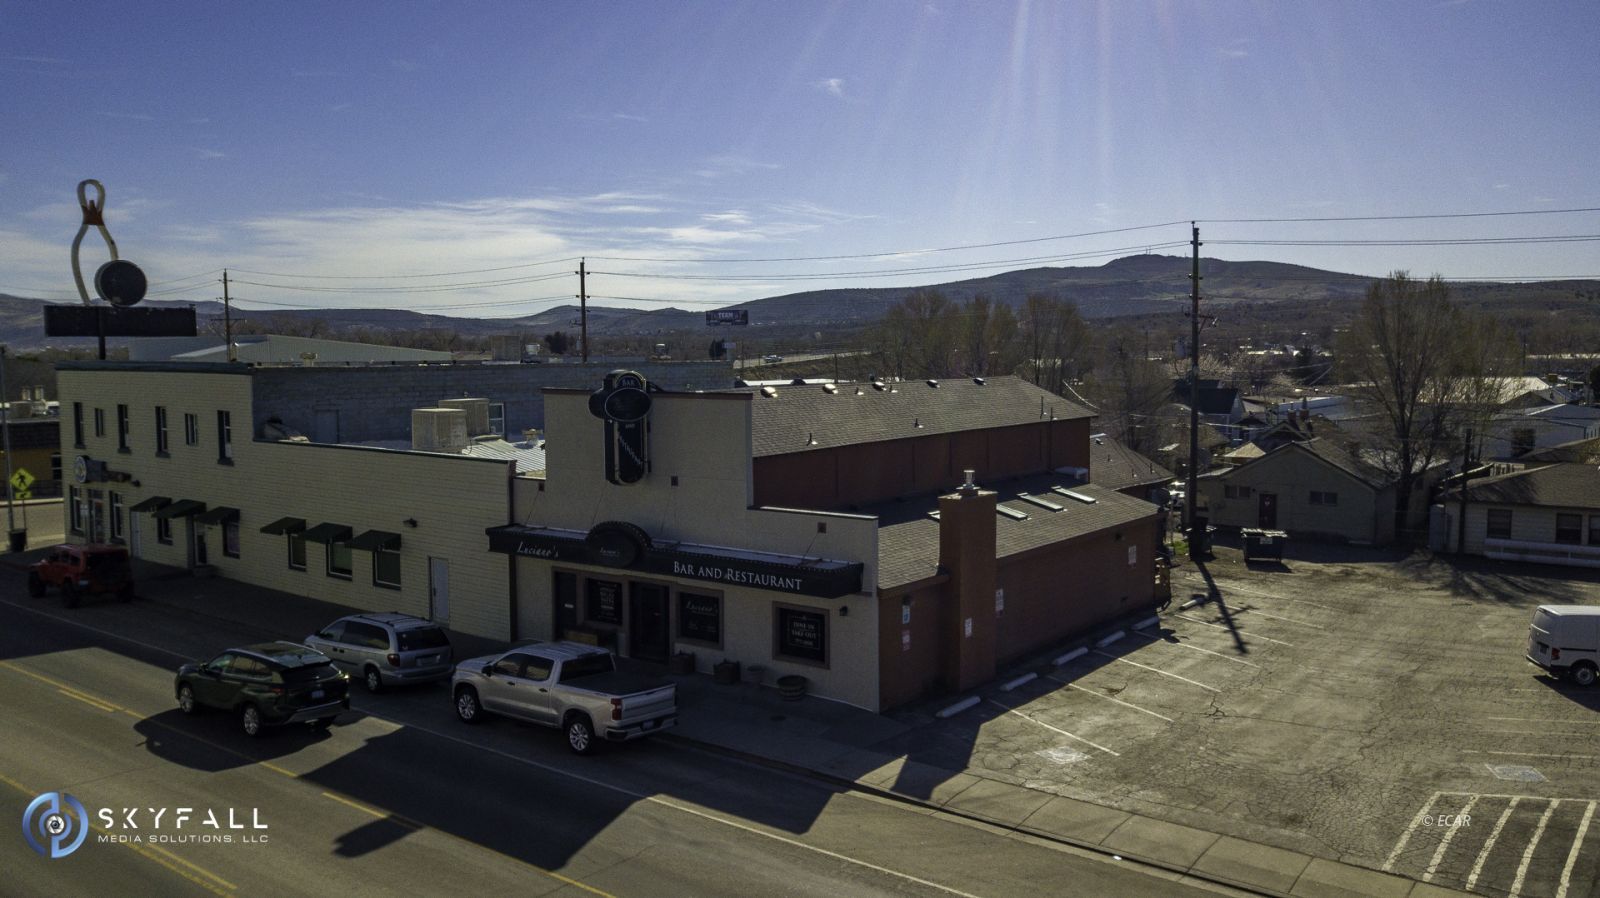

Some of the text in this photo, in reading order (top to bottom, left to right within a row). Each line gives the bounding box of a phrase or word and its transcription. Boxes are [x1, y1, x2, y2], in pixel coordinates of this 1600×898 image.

[673, 561, 803, 590] BAR AND RESTAURANT
